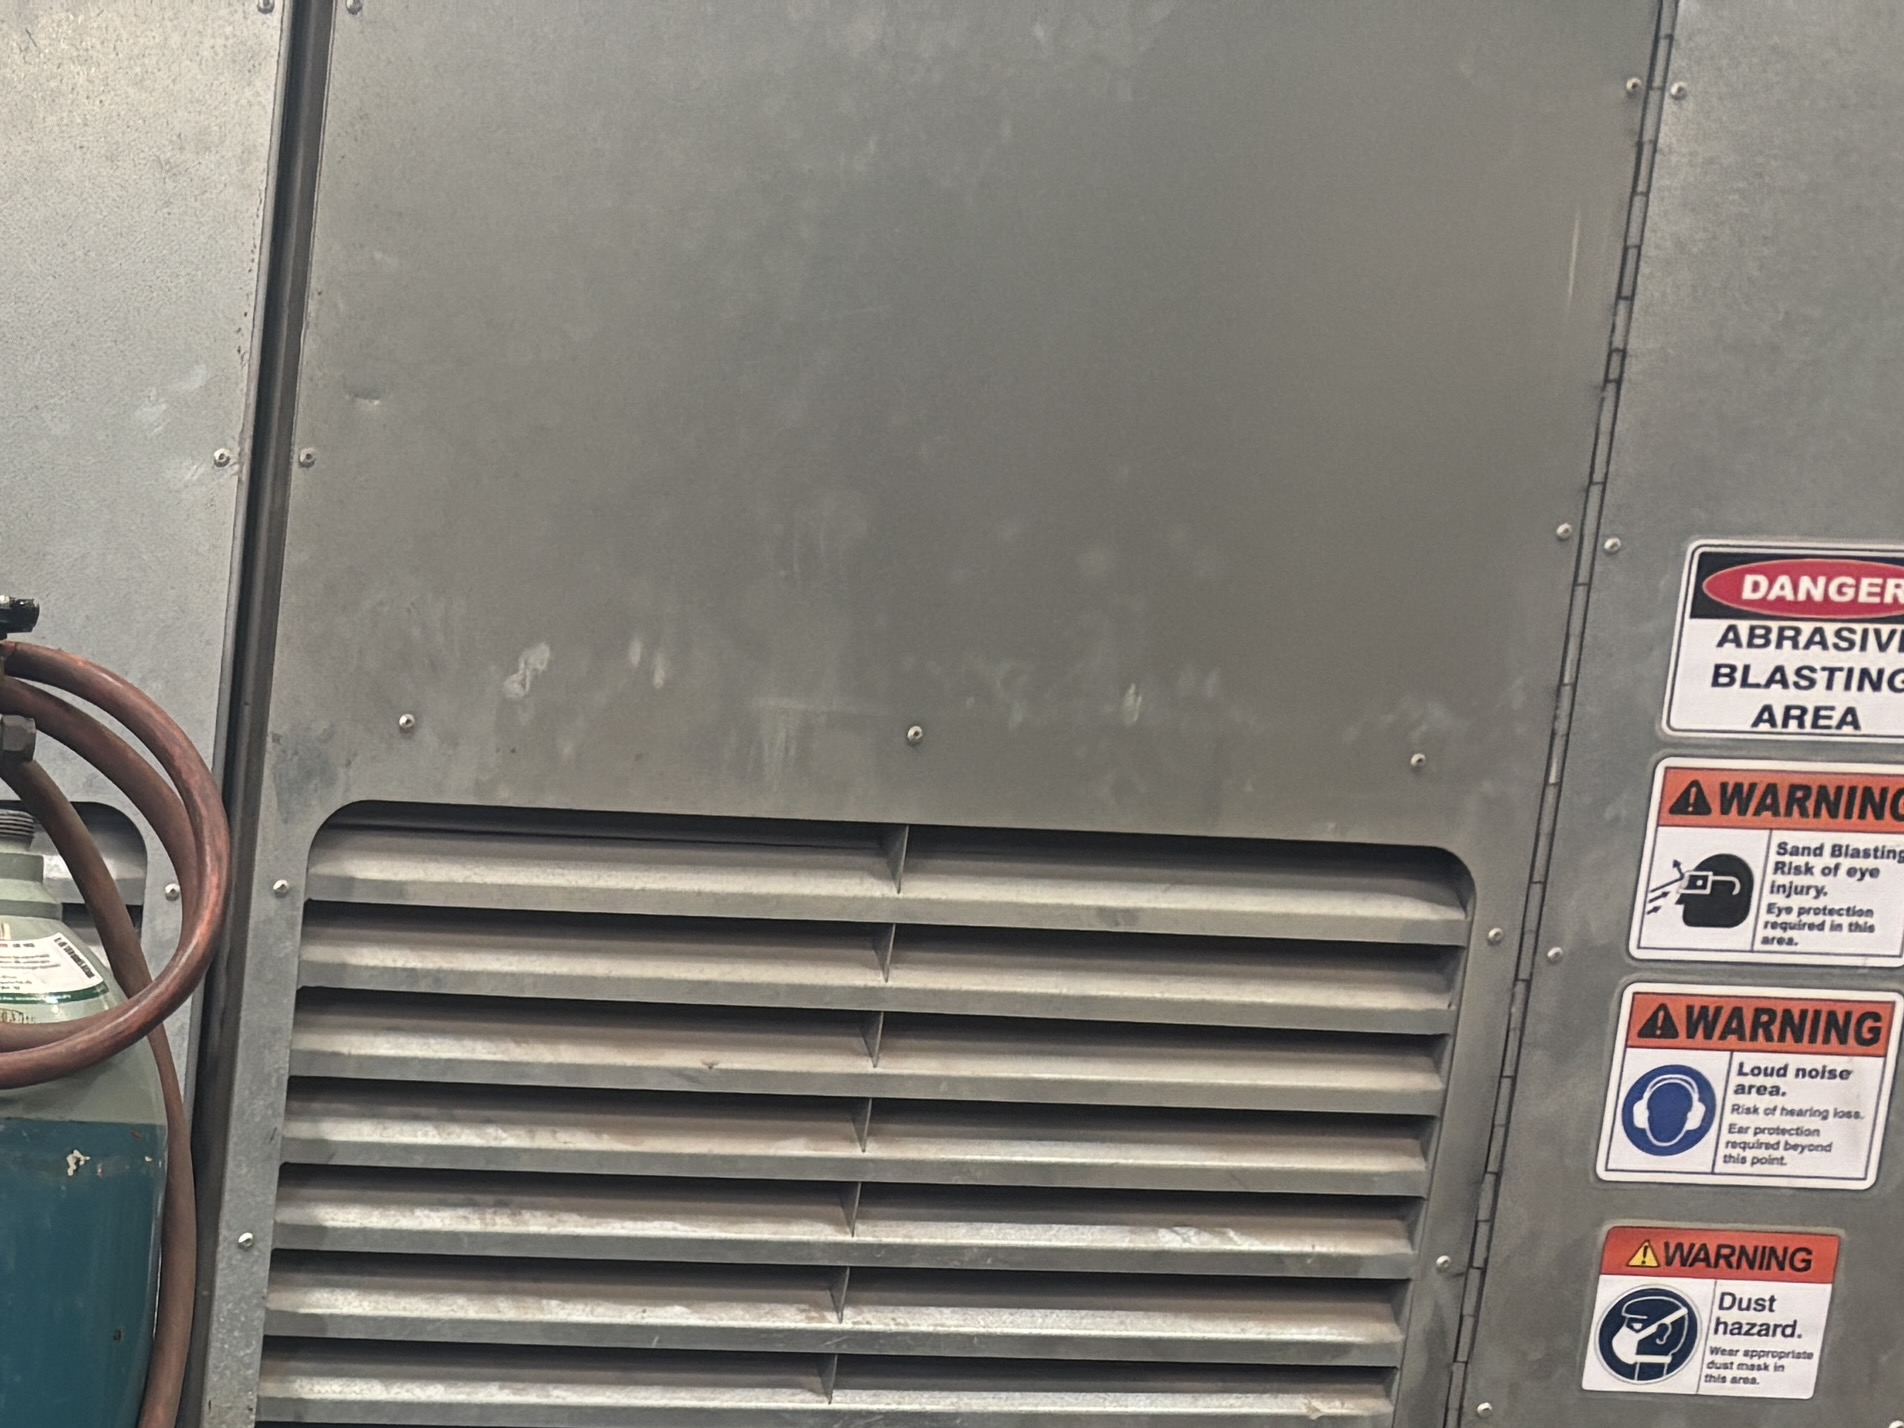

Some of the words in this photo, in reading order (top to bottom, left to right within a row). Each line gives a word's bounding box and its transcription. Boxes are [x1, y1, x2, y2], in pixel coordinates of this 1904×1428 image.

[1742, 574, 1904, 604] DANGER
[1716, 624, 1904, 653] ABRASIV
[1711, 664, 1904, 694] BLASTING
[1751, 704, 1862, 731] AREA
[1776, 841, 1825, 857] Sand
[1773, 860, 1814, 876] Risk
[1820, 862, 1841, 877] of
[1846, 866, 1881, 881] eye
[1769, 880, 1828, 899] injury.
[1766, 902, 1794, 917] Eye
[1797, 905, 1874, 918] protection
[1763, 919, 1826, 933] required
[1829, 920, 1843, 932] in
[1848, 921, 1875, 933] this
[1760, 936, 1799, 947] area.
[1686, 1005, 1882, 1047] WARNING
[1737, 1061, 1789, 1078] Loud
[1794, 1064, 1853, 1080] noise
[1733, 1083, 1787, 1097] area.
[1731, 1103, 1759, 1116] Risk
[1763, 1104, 1778, 1116] of
[1780, 1106, 1830, 1120] hearing
[1833, 1107, 1865, 1119] loss.
[1728, 1123, 1751, 1134] Ear
[1753, 1125, 1821, 1137] protection
[1725, 1139, 1781, 1152] required
[1784, 1140, 1833, 1154] beyond
[1722, 1153, 1747, 1165] this
[1750, 1154, 1787, 1167] point.
[1664, 1241, 1813, 1273] WARNING
[1718, 1291, 1777, 1313] Dust
[1714, 1316, 1802, 1339] hazard.
[1709, 1346, 1740, 1357] Wear
[1743, 1349, 1814, 1360] appropriate
[1706, 1360, 1734, 1370] dust
[1736, 1362, 1770, 1372] mask
[1773, 1362, 1785, 1372] in
[1704, 1373, 1727, 1383] this
[1730, 1375, 1760, 1385] area.
